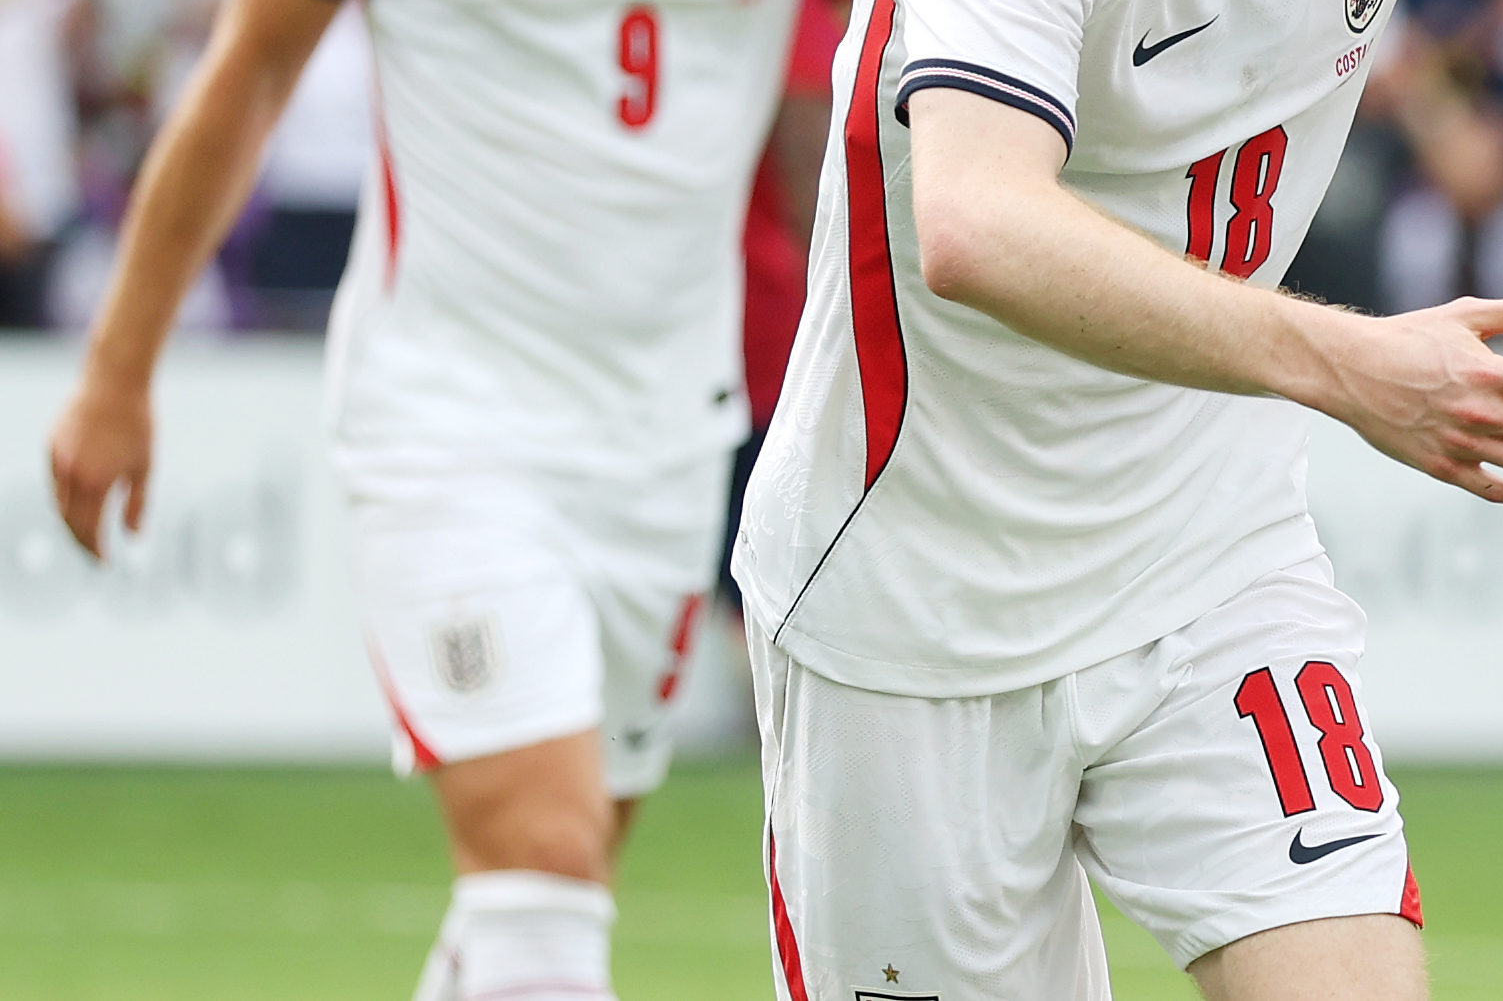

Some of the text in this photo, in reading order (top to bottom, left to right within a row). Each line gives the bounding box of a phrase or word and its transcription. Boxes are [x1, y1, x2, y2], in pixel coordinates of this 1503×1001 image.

[617, 8, 659, 131] 9
[1184, 124, 1288, 281] 18
[1233, 661, 1384, 818] 18
